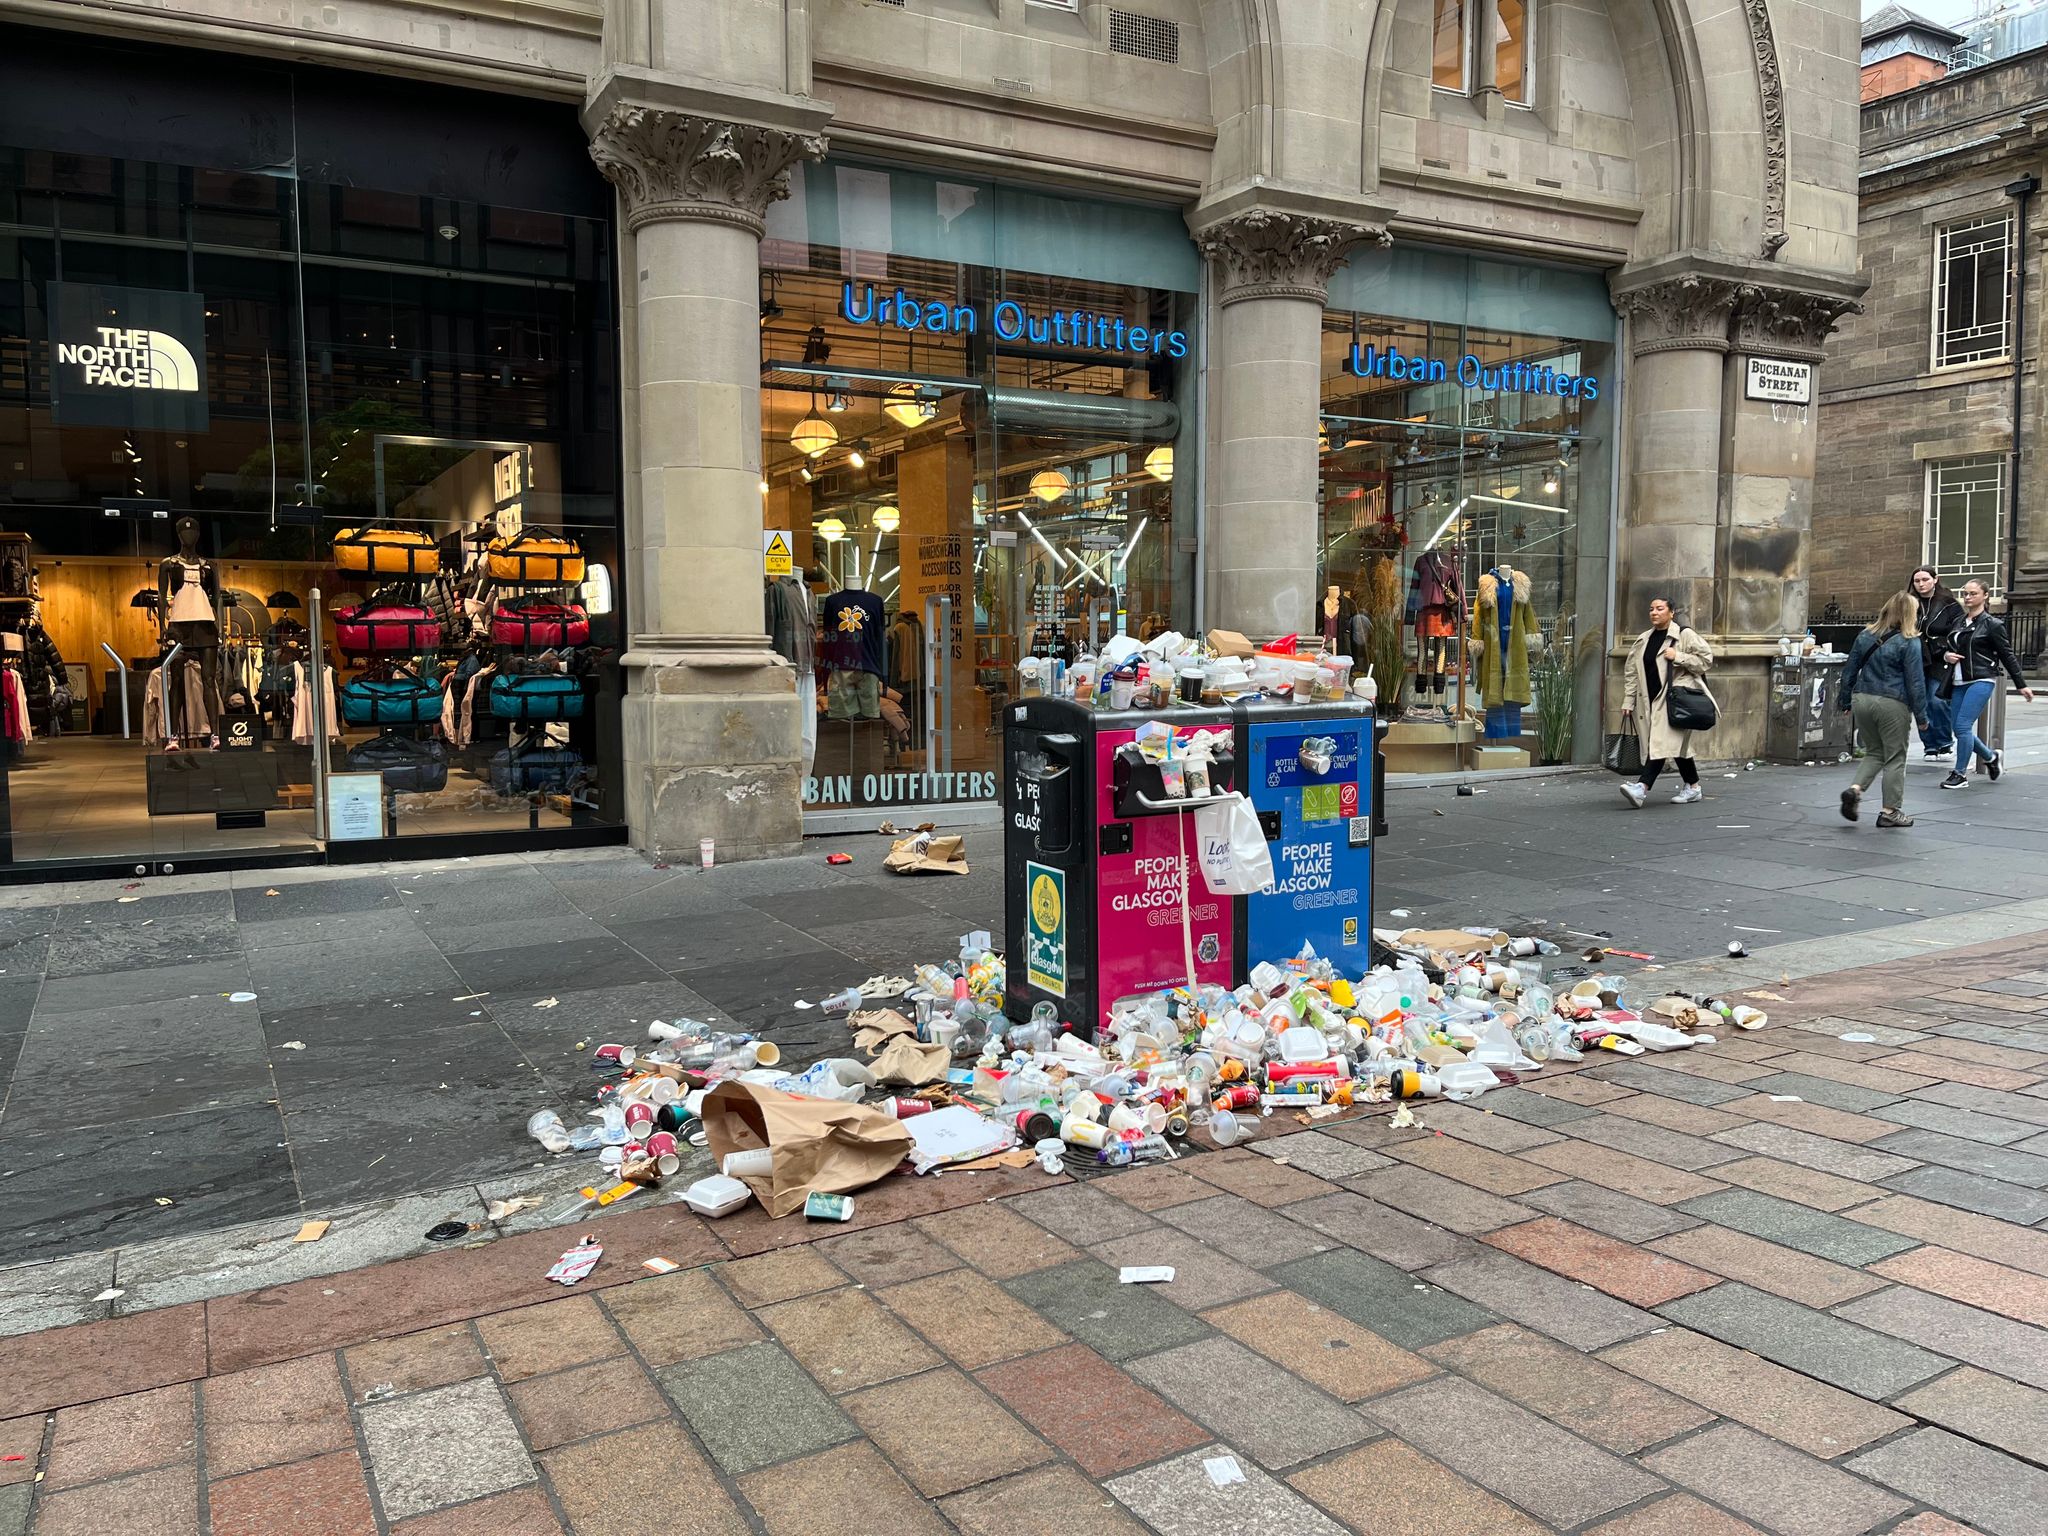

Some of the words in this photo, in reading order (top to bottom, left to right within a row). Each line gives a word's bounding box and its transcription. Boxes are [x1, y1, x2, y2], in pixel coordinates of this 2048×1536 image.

[843, 283, 977, 334] Urban
[994, 301, 1189, 358] Outfitters
[97, 327, 149, 349] THE
[58, 344, 150, 368] NORTH
[85, 364, 151, 388] FACE
[1351, 343, 1446, 382] Urban
[1458, 354, 1600, 400] Outfitters
[1751, 360, 1808, 378] BUCHANAN
[1759, 375, 1799, 392] STREET
[1275, 758, 1298, 767] BOTTLE
[1330, 754, 1357, 763] ECYCLING
[1333, 761, 1349, 769] ONLY
[1283, 765, 1296, 773] CAN
[805, 775, 851, 803] BAN
[863, 771, 997, 802] OUTFITTERS
[1015, 812, 1041, 832] GLAS
[1282, 842, 1333, 861] PEOPLE
[1135, 855, 1190, 875] PEOPLE
[1293, 858, 1332, 876] MAKE
[1261, 873, 1332, 895] GLASGOW
[1112, 888, 1189, 911] GLASGOW
[1292, 888, 1358, 911] GREENER
[1146, 903, 1219, 926] GREENER
[1031, 948, 1063, 976] Glasgow
[1030, 970, 1041, 983] CITY
[825, 1001, 847, 1011] COSTA
